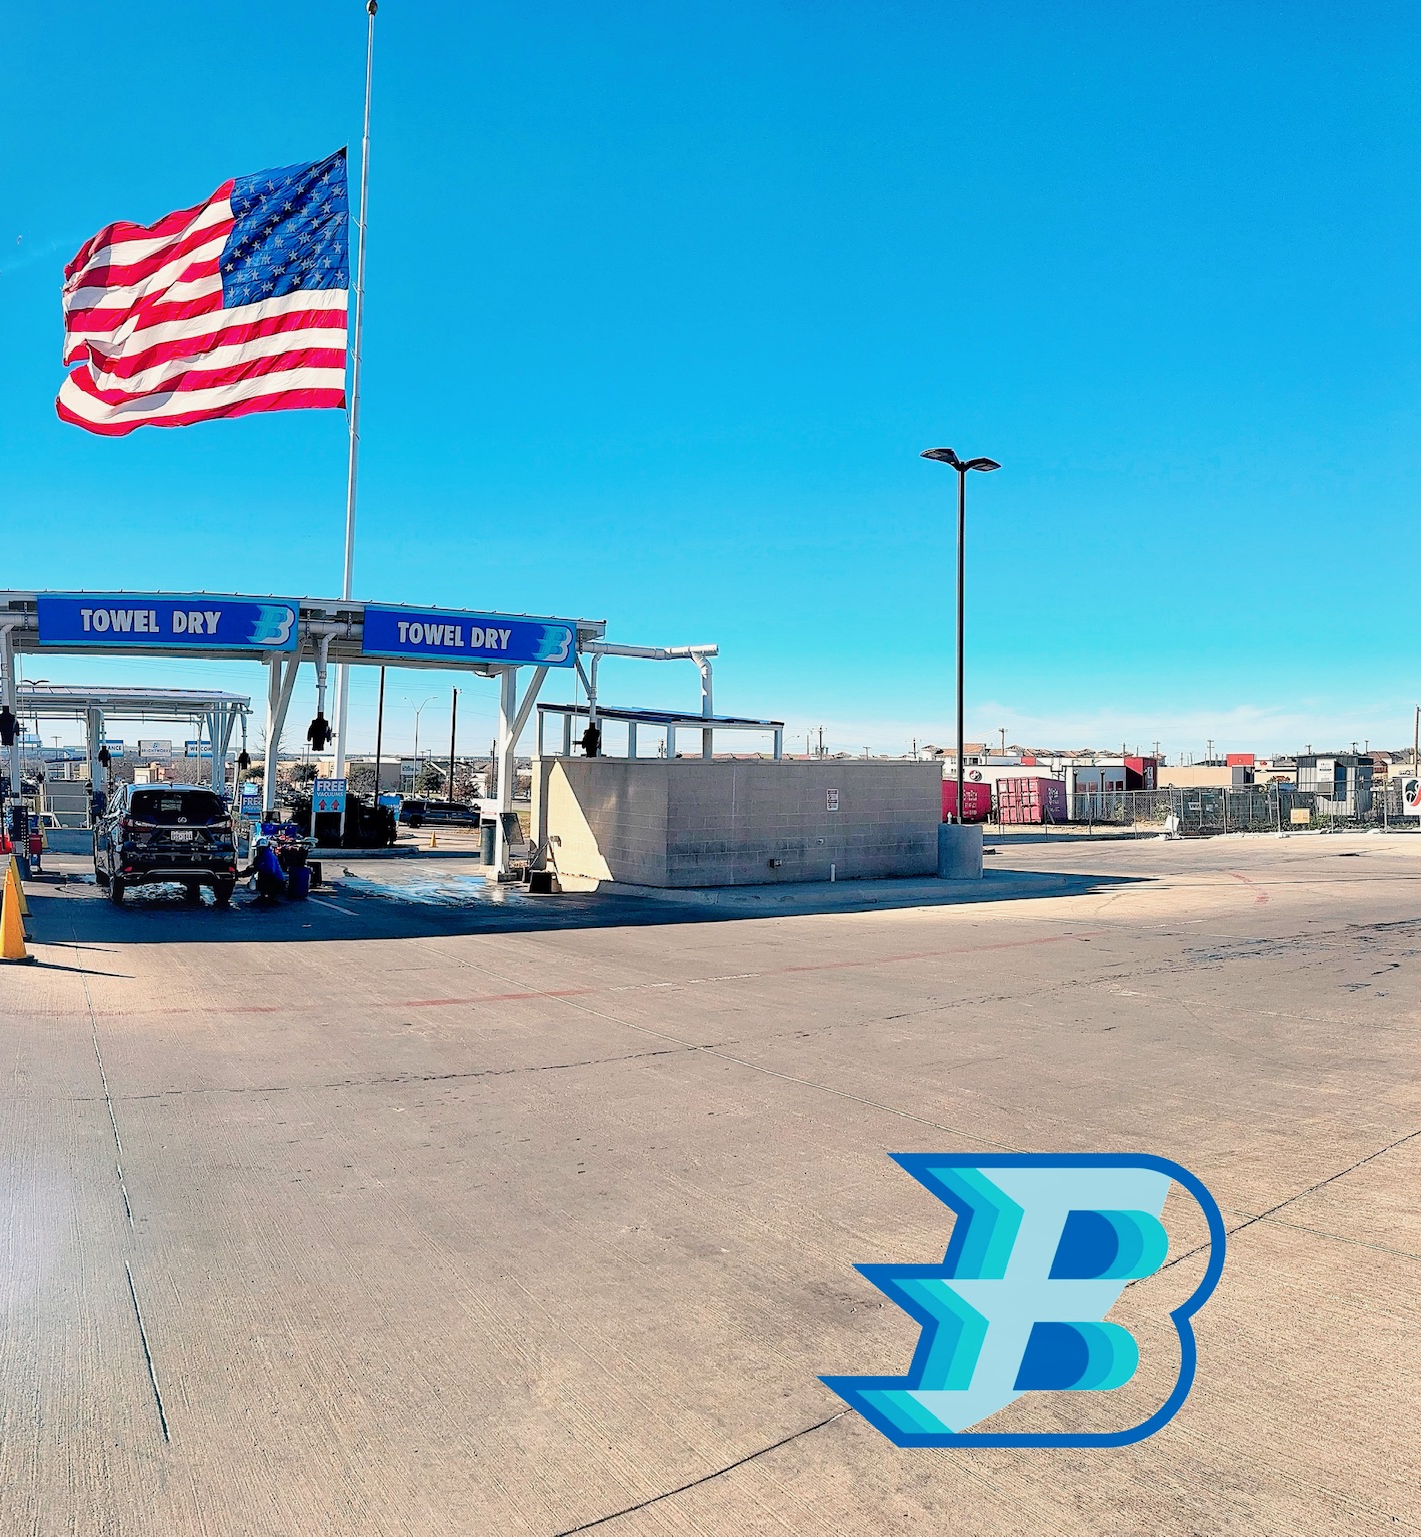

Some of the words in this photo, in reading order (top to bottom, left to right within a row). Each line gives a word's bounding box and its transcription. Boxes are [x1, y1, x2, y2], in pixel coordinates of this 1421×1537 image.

[81, 609, 160, 633] TOWEL
[172, 611, 222, 634] DRY
[398, 621, 465, 647] TOWEL
[471, 627, 512, 649] DRY
[317, 780, 344, 792] FREE
